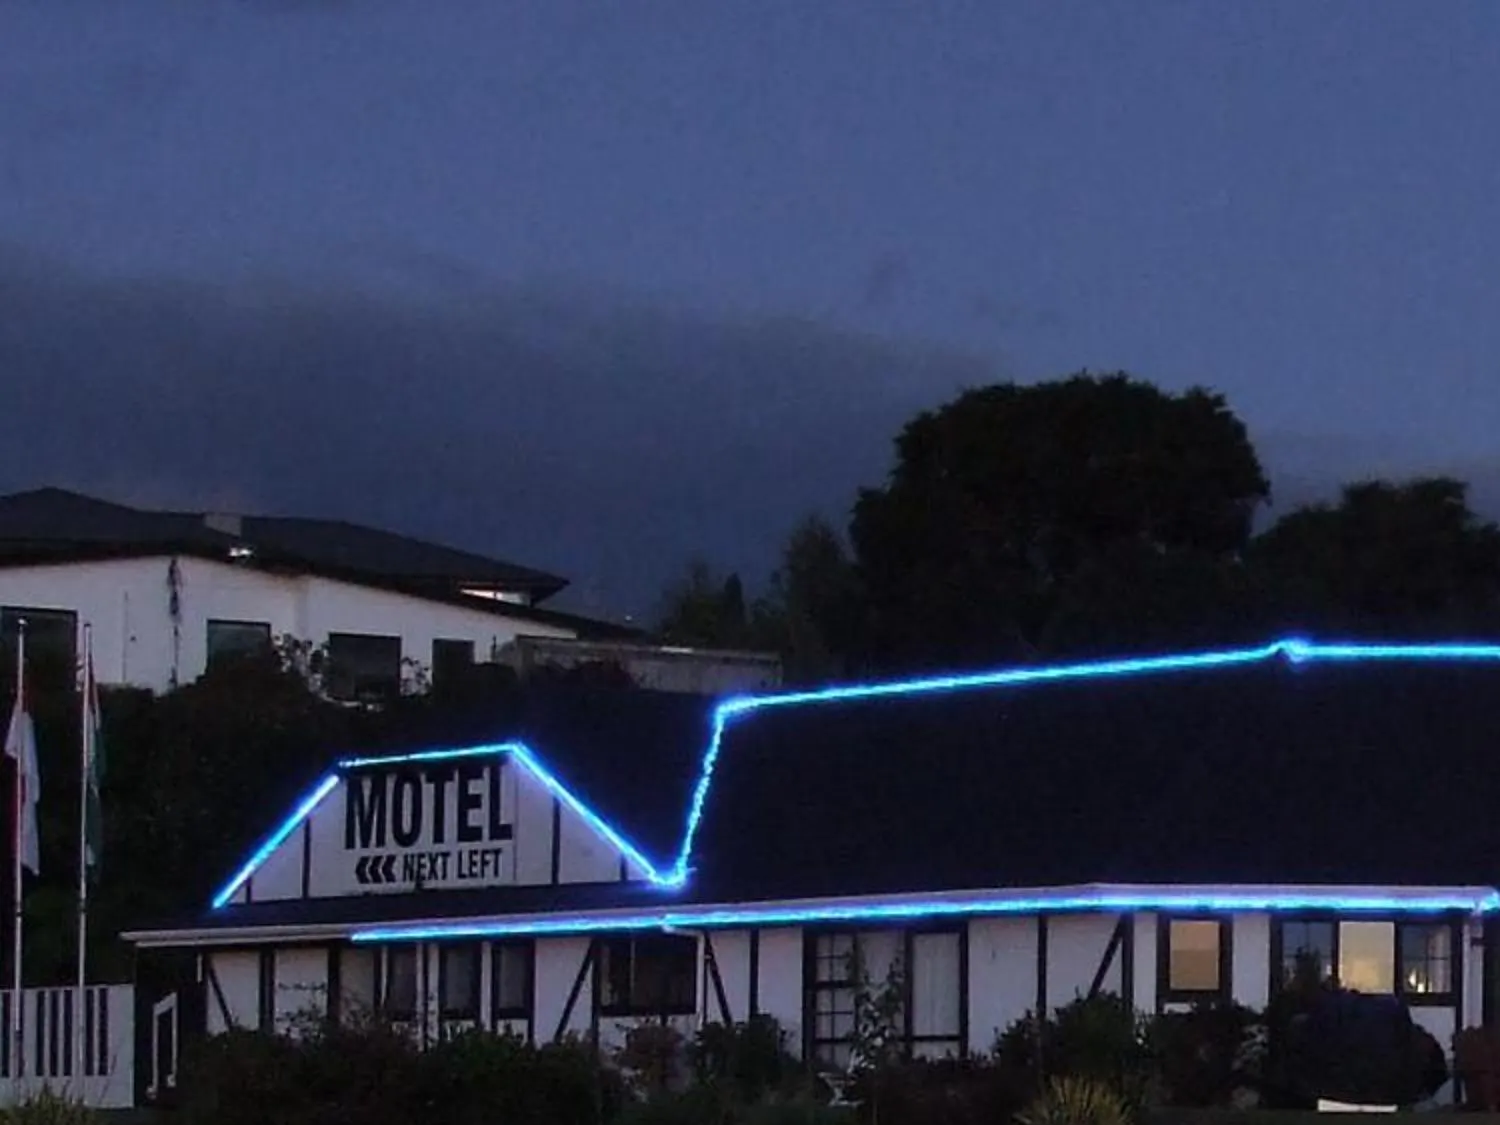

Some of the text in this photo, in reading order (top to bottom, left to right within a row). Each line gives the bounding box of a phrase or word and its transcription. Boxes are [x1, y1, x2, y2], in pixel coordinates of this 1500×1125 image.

[345, 767, 512, 849] MOTEL
[402, 849, 503, 882] NEXT LEFT
